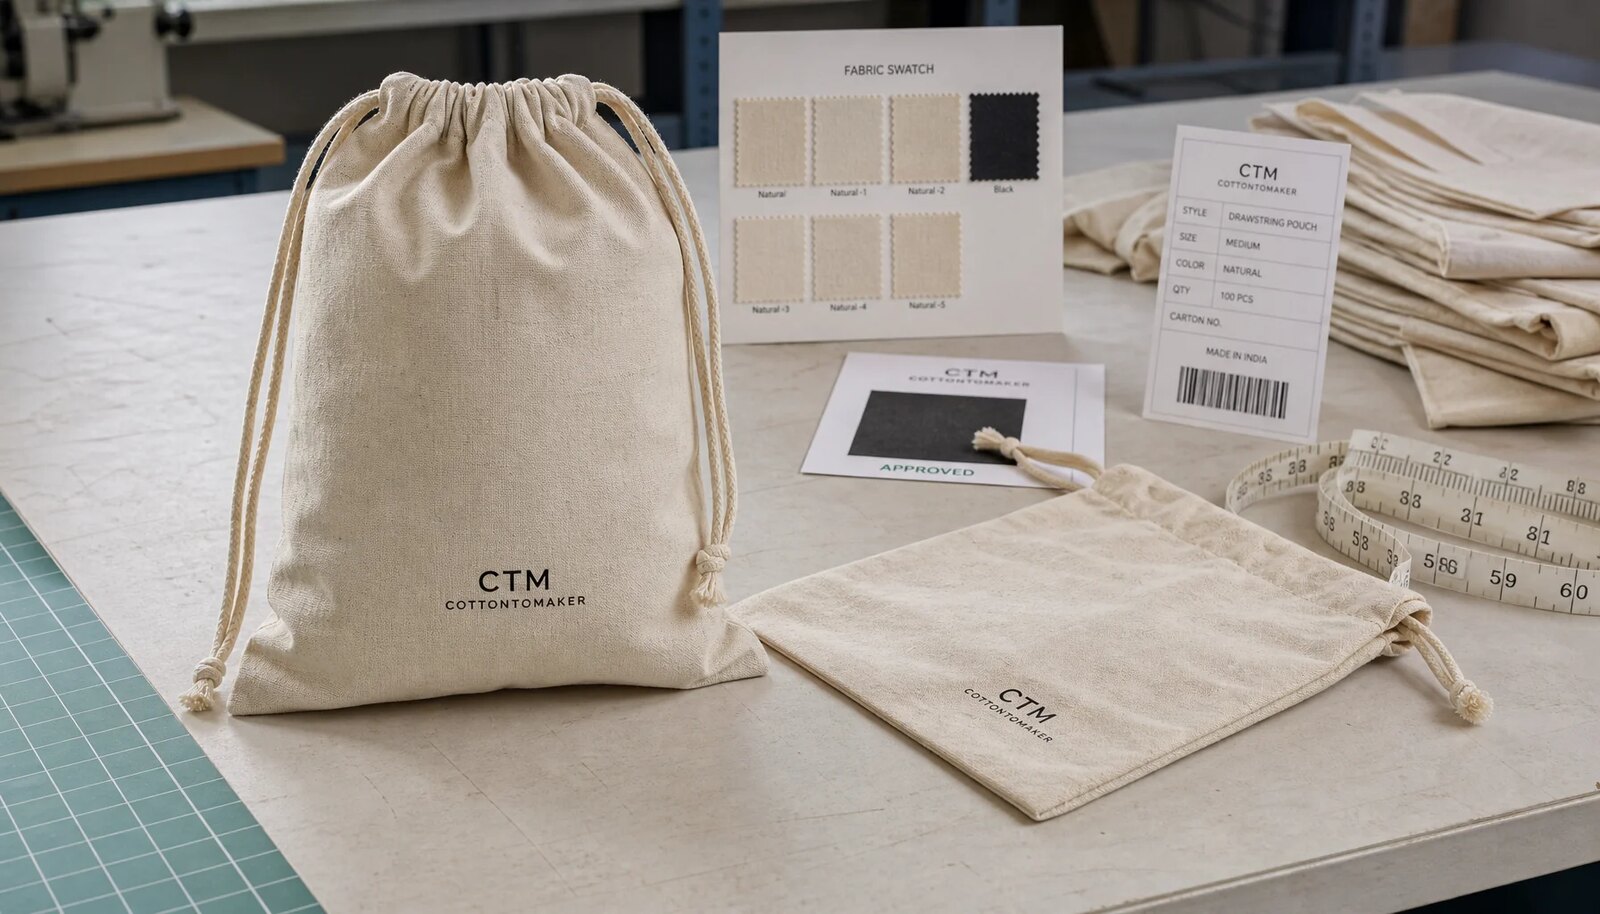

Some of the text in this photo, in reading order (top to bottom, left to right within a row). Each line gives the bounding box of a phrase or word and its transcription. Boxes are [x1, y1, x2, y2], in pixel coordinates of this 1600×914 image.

[844, 64, 934, 76] FABRIC SWATCH
[1239, 163, 1278, 181] CTM
[758, 190, 786, 198] Natural
[830, 189, 857, 197] Natural
[908, 187, 935, 195] Natural
[994, 185, 1014, 194] Black
[1218, 180, 1297, 196] COTTONTOMAKER
[1182, 206, 1208, 218] STYLE
[1228, 212, 1318, 232] DRAWSTRING POUCH
[1179, 232, 1197, 242] SIZE
[1226, 238, 1261, 251] MEDIUM
[1175, 258, 1205, 270] COLOR
[1223, 265, 1262, 278] NATURAL
[1172, 285, 1191, 296] QTY
[1220, 291, 1254, 304] 100 PCS
[781, 305, 790, 313] -3
[830, 303, 867, 312] Natural -4
[909, 301, 946, 310] Natural -5
[1169, 312, 1221, 327] CARTON NO.
[1206, 347, 1268, 365] MADE IN INDIA
[945, 368, 999, 379] CTM
[908, 376, 1031, 387] COTTONTOMAKER
[879, 463, 975, 477] APPROVED
[479, 569, 549, 592] CTM
[1560, 583, 1588, 600] 60
[445, 596, 586, 610] COTTONTOMAKER
[999, 688, 1057, 724] CTM
[964, 688, 1053, 743] COTTONTOMAKER
